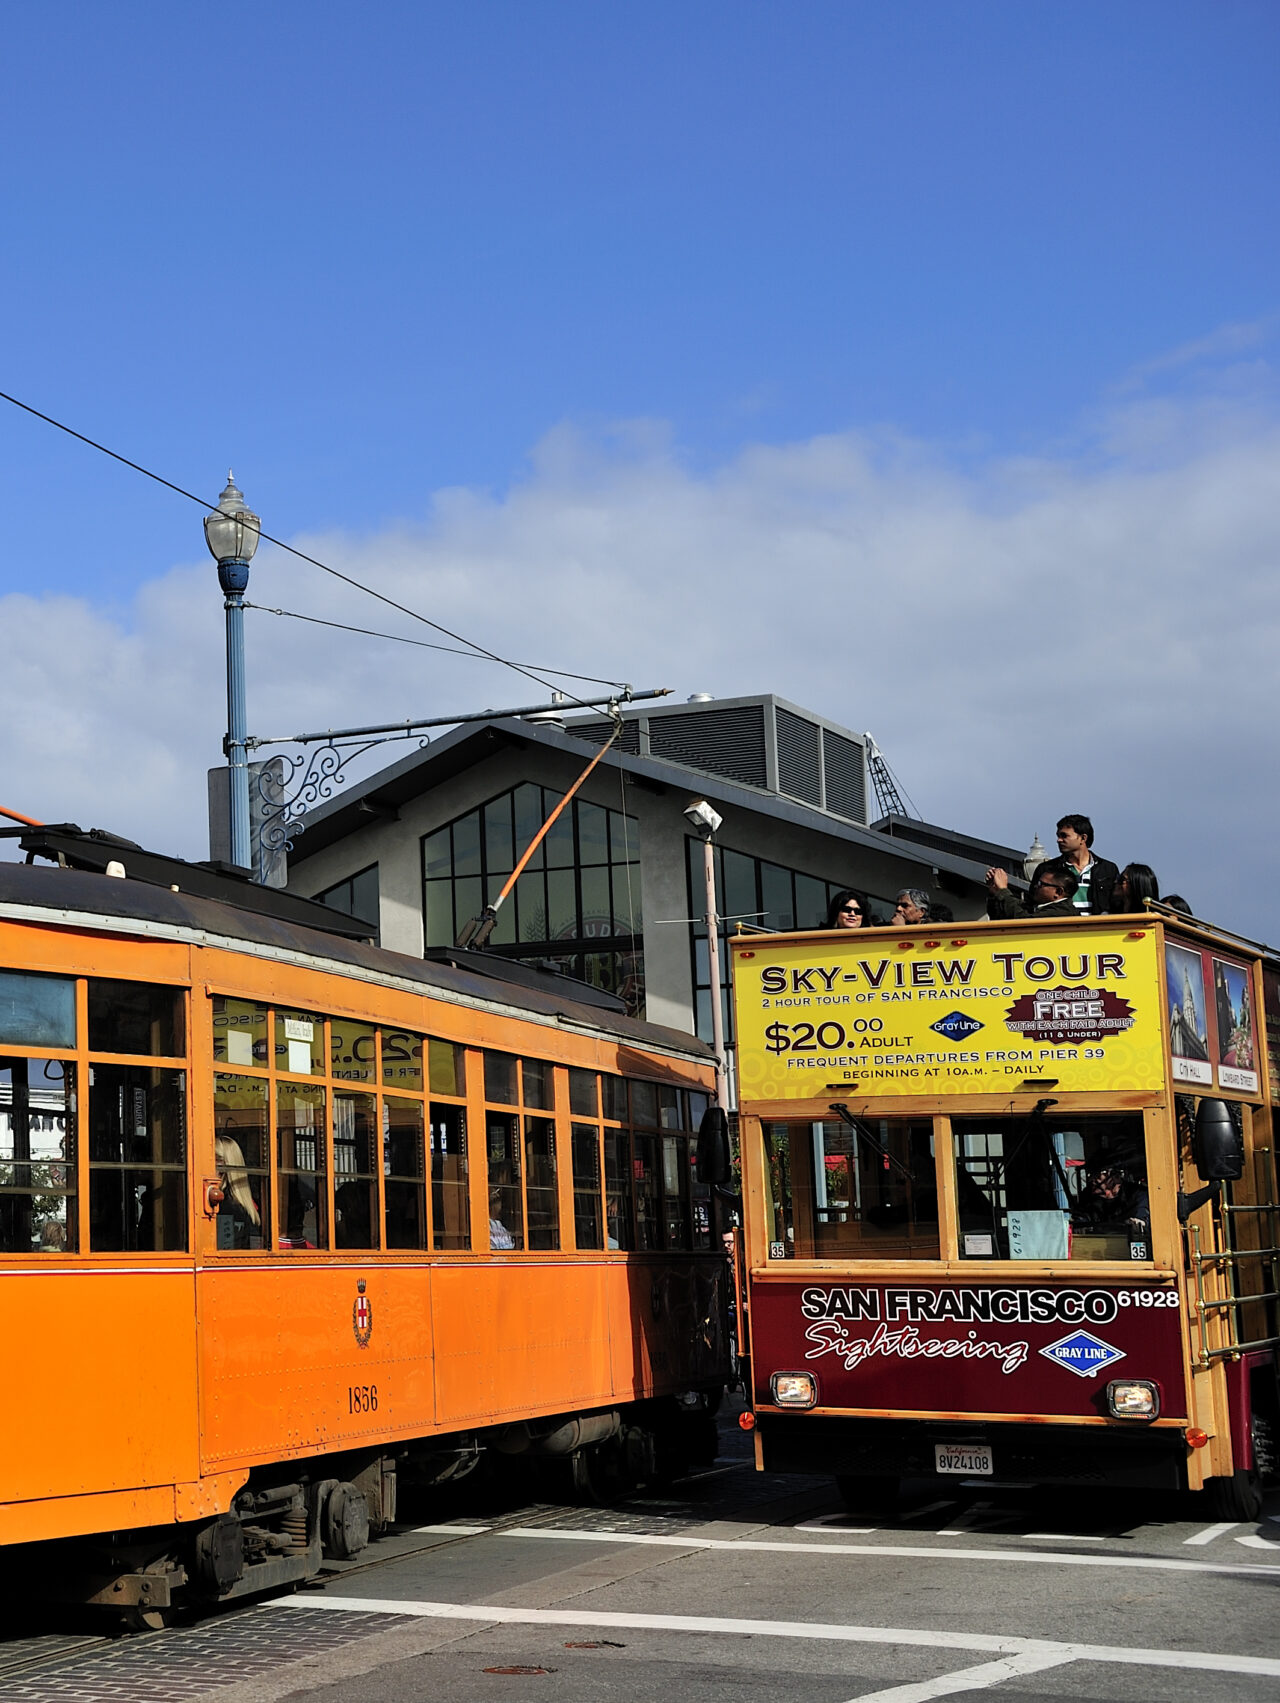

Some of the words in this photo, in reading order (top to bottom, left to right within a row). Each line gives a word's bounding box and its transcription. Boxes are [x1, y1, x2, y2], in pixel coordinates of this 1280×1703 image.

[992, 952, 1127, 982] TOUR
[762, 998, 770, 1008] 2
[775, 997, 811, 1007] HOUR
[815, 995, 850, 1005] TOUR
[855, 993, 876, 1003] OF
[881, 991, 912, 1001] SAN
[918, 986, 1013, 1000] FRANCISCO
[1036, 990, 1063, 1000] ONE
[1063, 989, 1100, 999] CHILD
[1033, 999, 1105, 1020] FREE
[1006, 1020, 1037, 1031] WITH
[1038, 1020, 1069, 1030] EACH
[1070, 1019, 1097, 1029] PAID
[1097, 1018, 1136, 1028] ADULT
[787, 1055, 869, 1068] FREQUENT
[874, 1051, 980, 1066] DEPARTURES
[985, 1050, 1033, 1062] FROM
[1040, 1049, 1078, 1060] PIER
[1084, 1048, 1105, 1058] 39
[843, 1068, 920, 1079] BEGINNING
[924, 1068, 941, 1077] AT
[1004, 1065, 1045, 1075] DAILY
[1011, 1217, 1023, 1255] 61928
[772, 1246, 784, 1258] 35
[1132, 1246, 1146, 1259] 35
[801, 1287, 880, 1321] SAN
[885, 1288, 1118, 1324] FRANCISCO
[1117, 1290, 1180, 1308] 61928
[805, 1320, 1029, 1374] Sightseeing
[1055, 1347, 1084, 1359] GRAY
[1084, 1347, 1108, 1359] LINE
[348, 1384, 378, 1414] 1856
[939, 1454, 989, 1470] 8V24108
